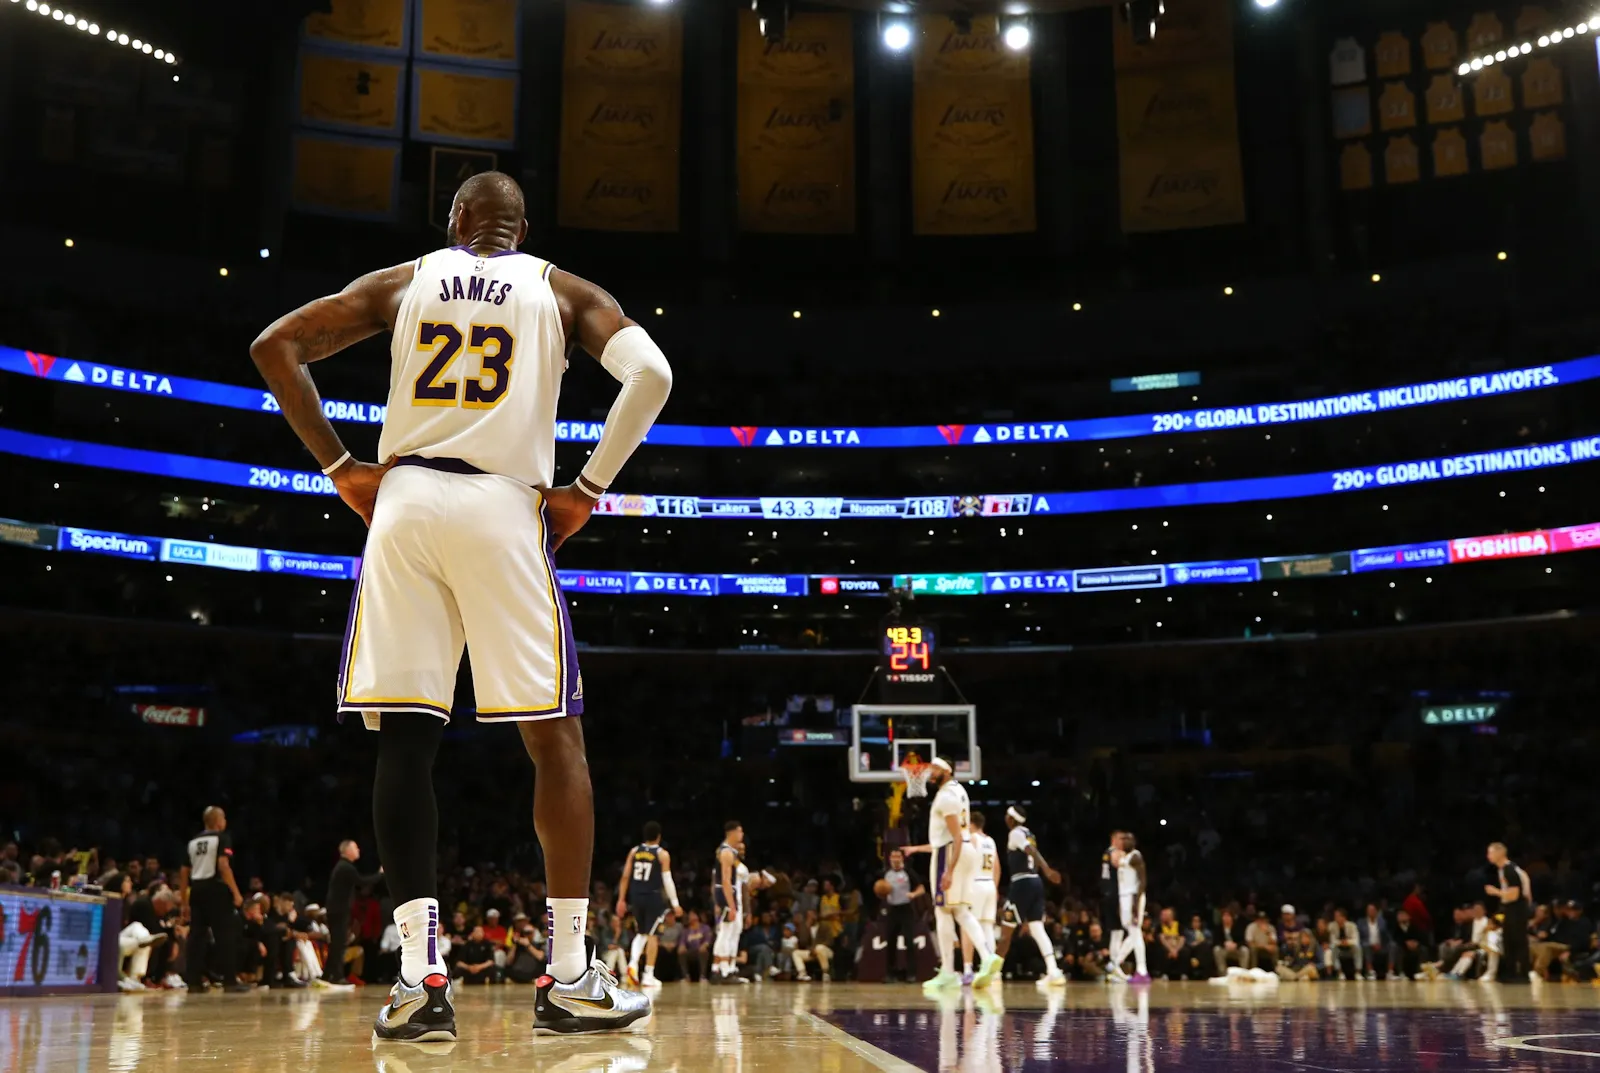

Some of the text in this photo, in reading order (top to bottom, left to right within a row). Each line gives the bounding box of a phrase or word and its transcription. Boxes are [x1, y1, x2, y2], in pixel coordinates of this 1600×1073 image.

[939, 33, 998, 54] LAKER
[940, 105, 1005, 127] LAKERS
[942, 179, 1008, 205] LAKERS
[439, 276, 512, 305] JAMES
[411, 320, 516, 410] 23
[92, 366, 172, 394] DELTA
[1131, 373, 1178, 384] AMERICAN
[1153, 366, 1559, 432] 290+ GLOBAL DESTINATIONS, INCLUDING PLAYOFFS.
[324, 401, 366, 421] OBAL
[789, 430, 860, 444] DELTA
[996, 424, 1069, 440] DELTA
[1332, 470, 1374, 491] 290+
[1377, 461, 1440, 485] GLOBAL
[1443, 443, 1570, 477] DESTINATIONS,
[249, 467, 337, 494] 290+ GLOB
[660, 499, 694, 515] 116
[712, 503, 750, 514] Lakers
[772, 501, 815, 516] 43.3
[850, 503, 897, 515] Nuggets
[911, 500, 944, 516] 108
[70, 530, 148, 554] Spectrum
[1453, 535, 1548, 559] TOSHIBA
[173, 546, 253, 566] UCLA Health
[1404, 547, 1446, 562] ULTRA
[285, 559, 343, 572] crypto.com
[1190, 566, 1248, 579] crypto.com
[586, 577, 623, 587] ULTRA
[653, 577, 711, 591] DELTA
[735, 577, 786, 586] AMERICAN
[742, 585, 787, 593] EXPRESS
[840, 580, 879, 590] TOYOTA
[934, 576, 975, 592] Sprite
[1010, 575, 1068, 589] DELTA
[887, 627, 922, 644] 43.3
[890, 643, 929, 670] 24
[900, 674, 935, 682] TISSOT
[1441, 707, 1496, 722] DELTA
[806, 732, 834, 740] TOYOTA
[982, 854, 993, 871] 15
[633, 861, 653, 881] 27
